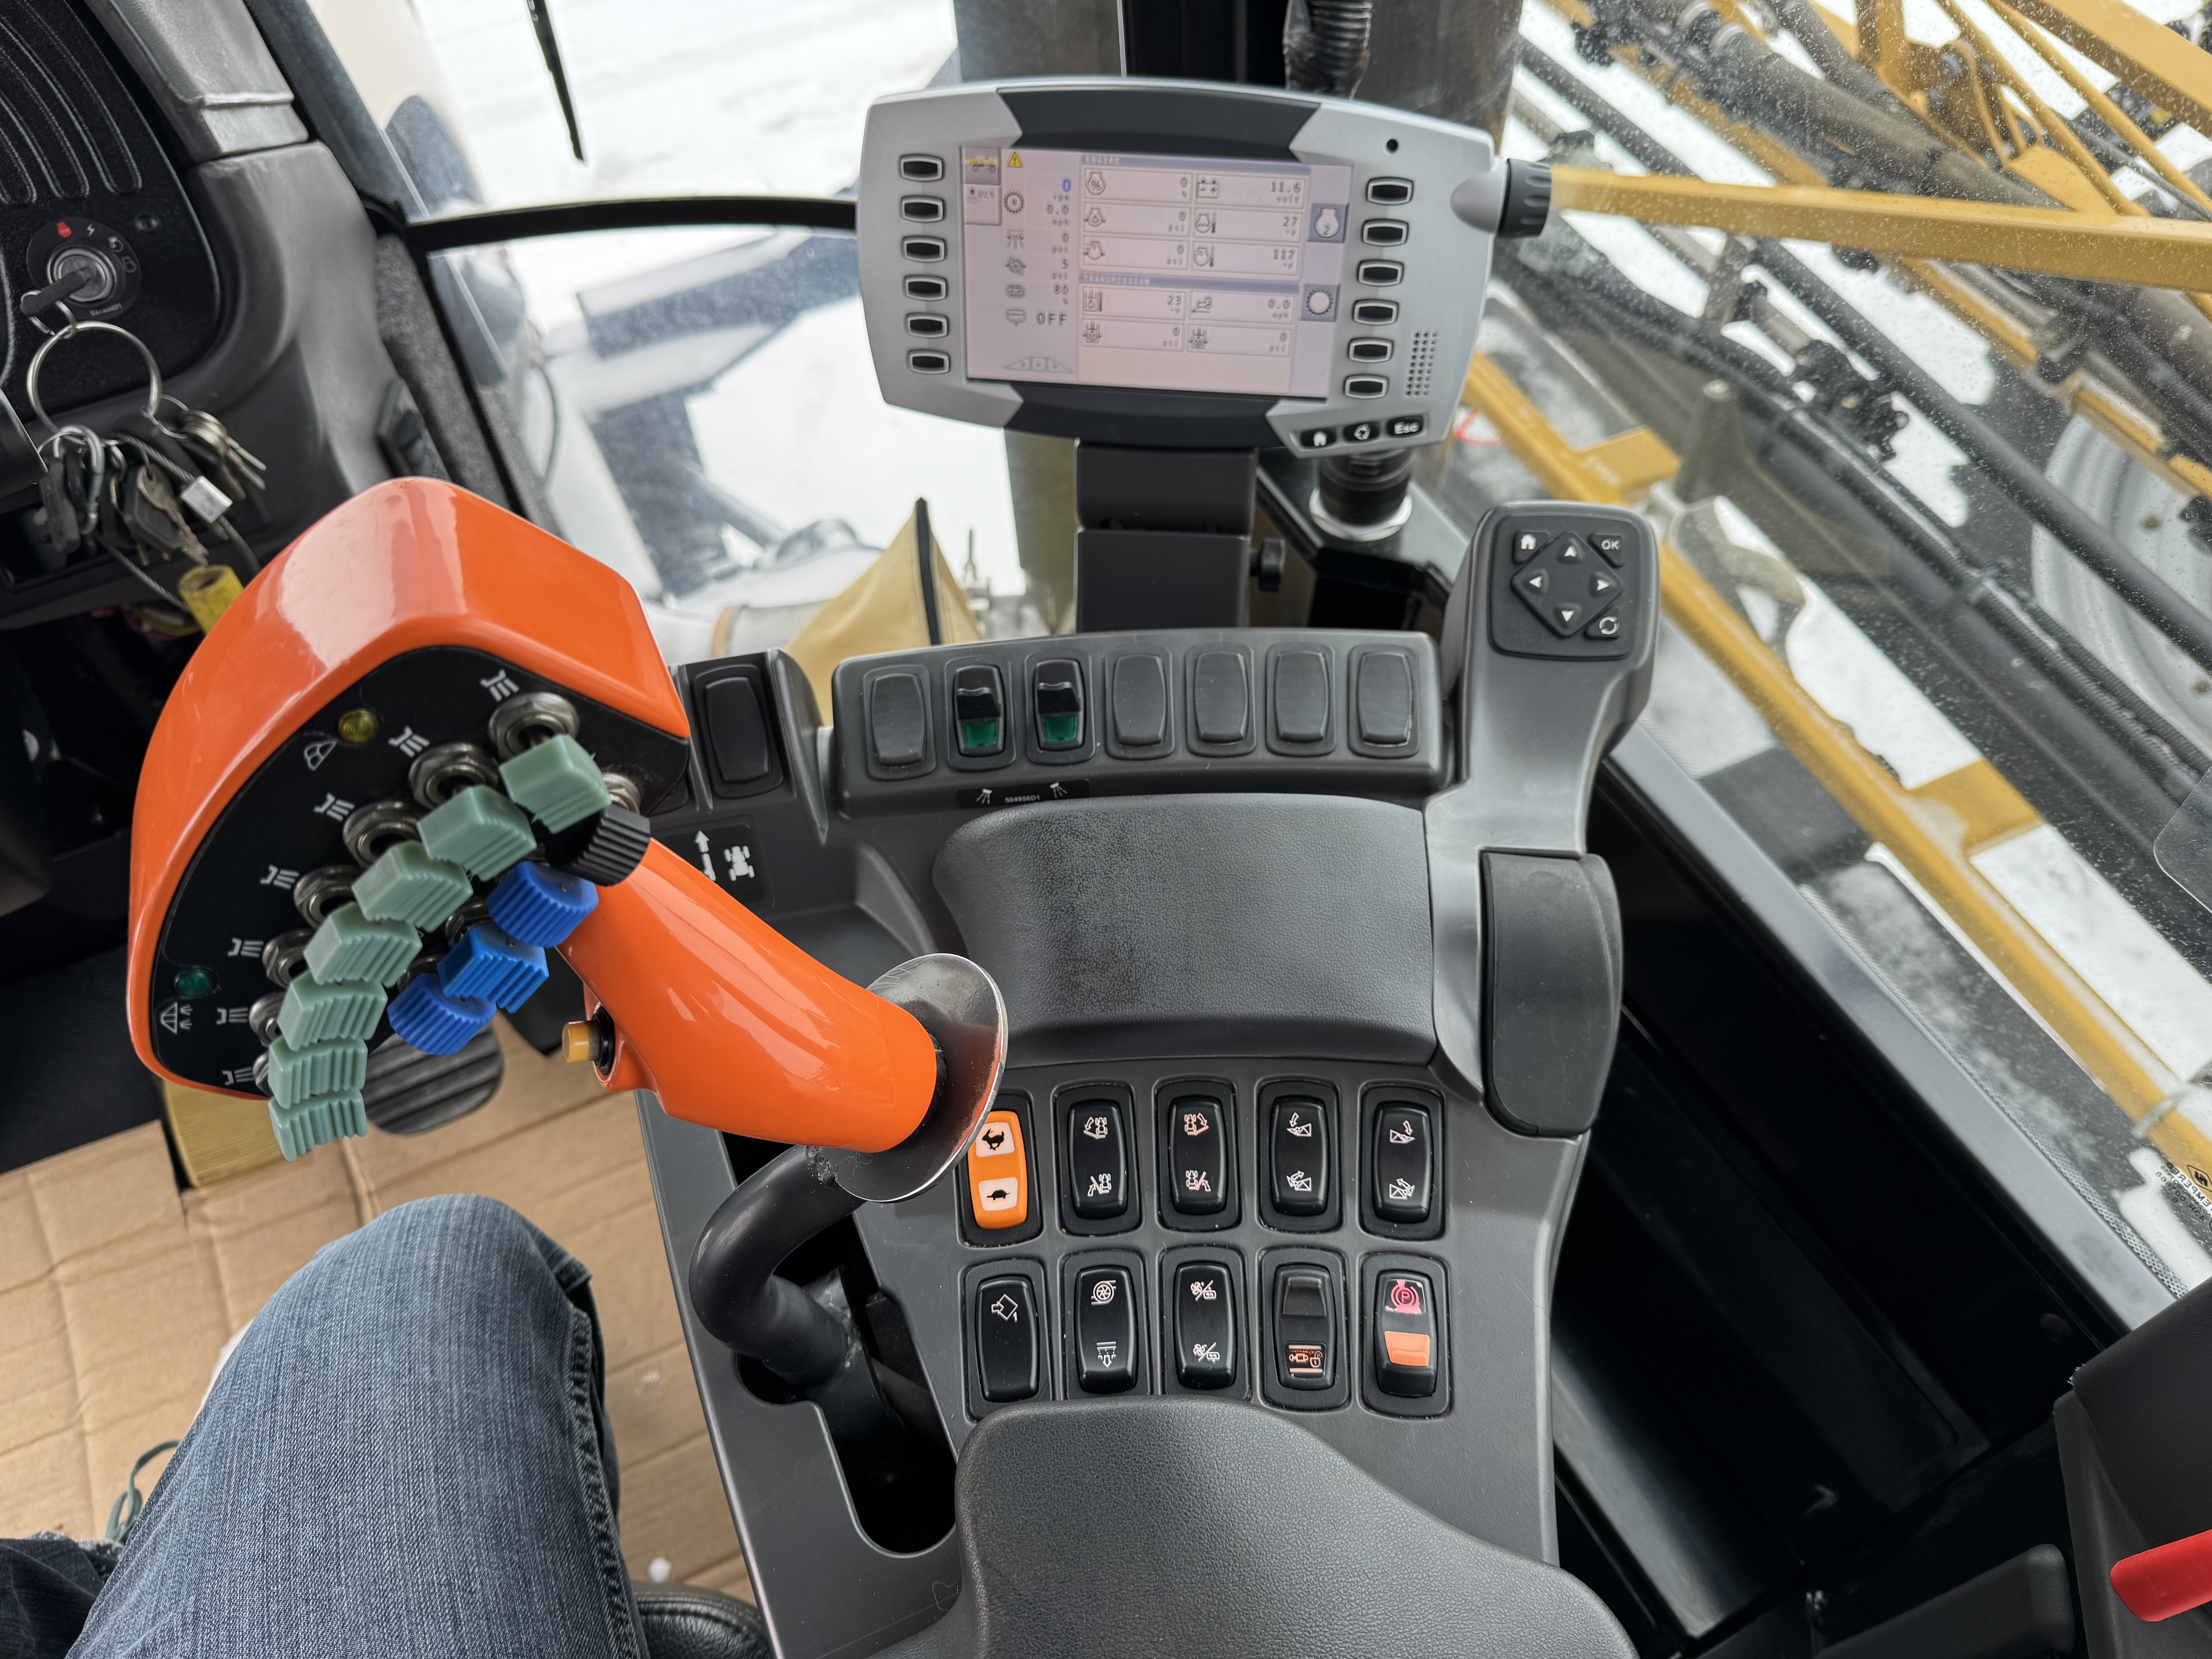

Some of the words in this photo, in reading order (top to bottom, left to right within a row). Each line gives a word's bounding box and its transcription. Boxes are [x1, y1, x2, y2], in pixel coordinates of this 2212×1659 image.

[1062, 179, 1071, 192] 0
[1180, 177, 1188, 188] 0
[1271, 181, 1301, 194] 11.6
[1046, 201, 1070, 215] 0.0
[1178, 211, 1187, 222] 0
[1283, 216, 1298, 227] 27
[1061, 232, 1070, 243] 0
[1176, 244, 1185, 255] 0
[1273, 249, 1295, 260] 117
[1061, 258, 1069, 270] 5
[1053, 282, 1069, 295] 80
[1167, 294, 1182, 306] 23
[1267, 297, 1291, 310] 0.0
[1036, 311, 1067, 326] OFF
[1172, 326, 1180, 337] 0
[1279, 331, 1288, 343] 0
[1394, 421, 1420, 434] Esc
[1601, 539, 1622, 550] OK
